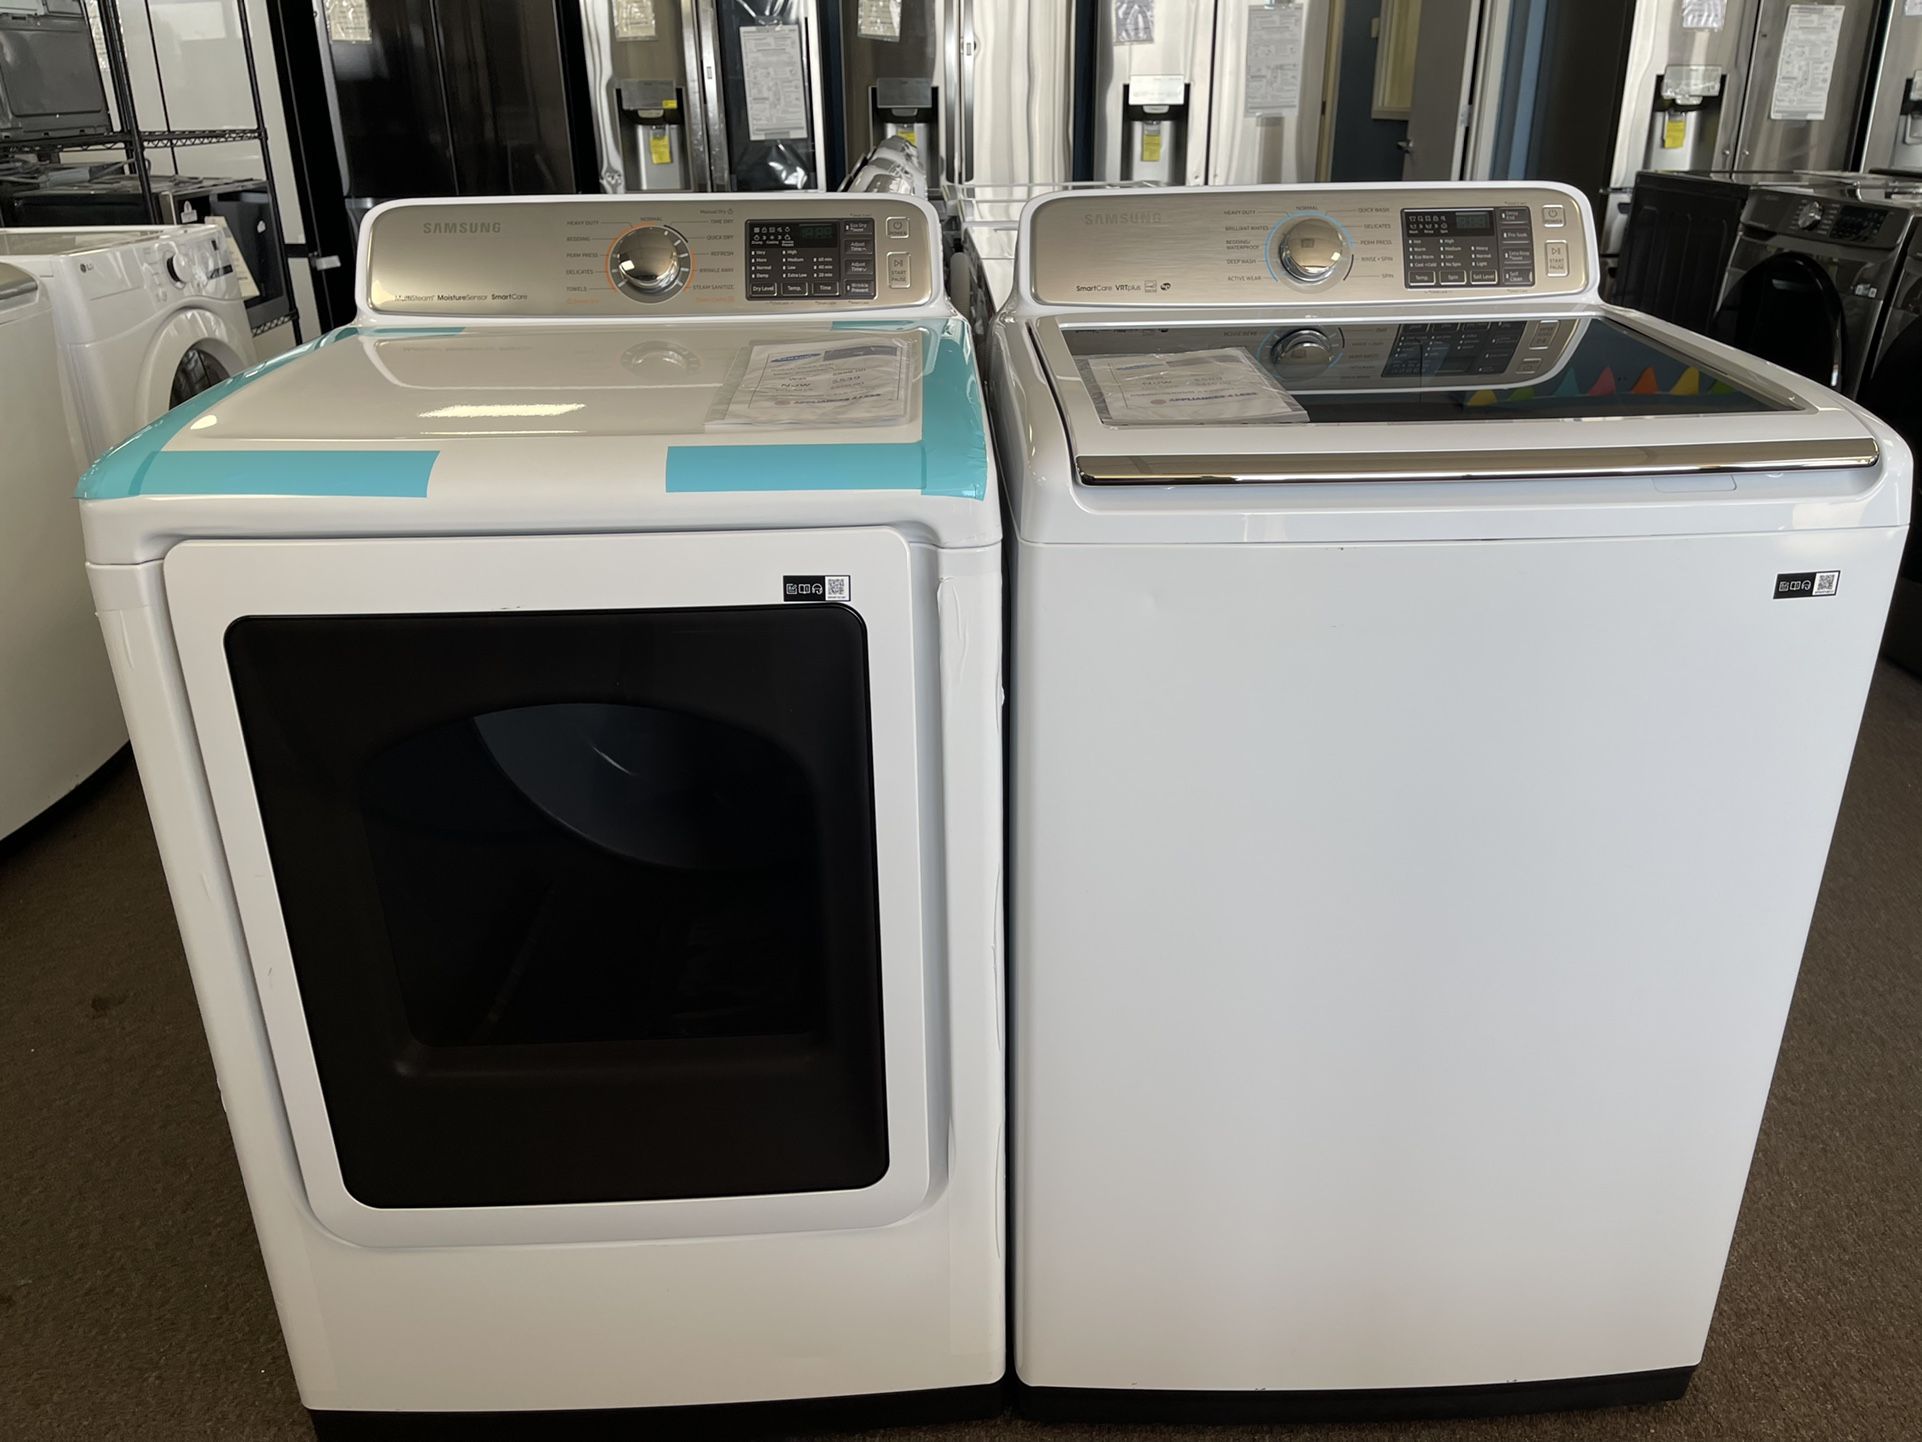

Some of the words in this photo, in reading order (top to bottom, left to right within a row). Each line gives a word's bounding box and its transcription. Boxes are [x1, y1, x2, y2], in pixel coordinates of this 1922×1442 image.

[1083, 212, 1162, 225] SAMSUNG
[423, 222, 501, 234] SAMSUNG
[491, 293, 528, 301] SmartCare
